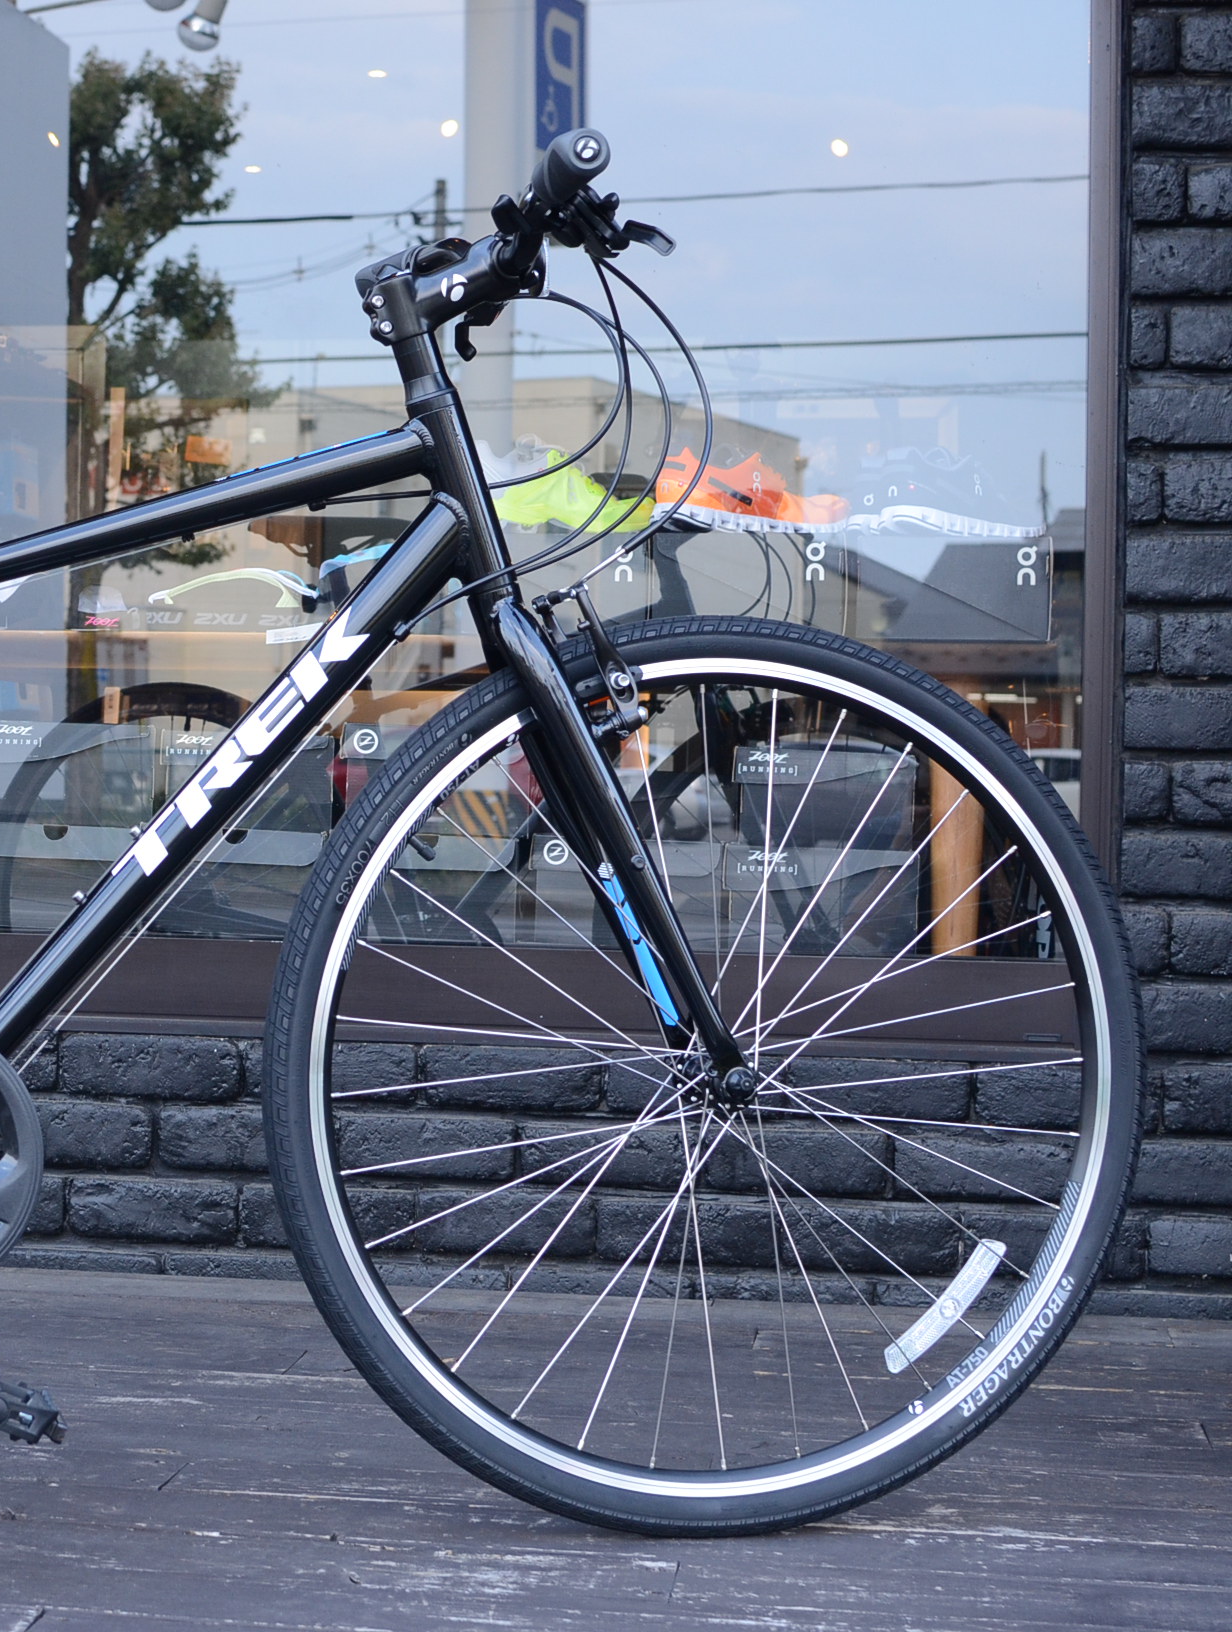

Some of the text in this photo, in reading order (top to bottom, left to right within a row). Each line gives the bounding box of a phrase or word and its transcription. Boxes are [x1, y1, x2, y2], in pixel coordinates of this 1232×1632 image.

[193, 612, 248, 625] 2XU
[111, 606, 370, 877] TREK
[411, 741, 457, 786] BONTRAGER
[439, 759, 481, 801] AT-750
[335, 838, 375, 905] 700x35
[945, 1345, 989, 1389] AT-750
[958, 1295, 1067, 1418] BONTRAGER
